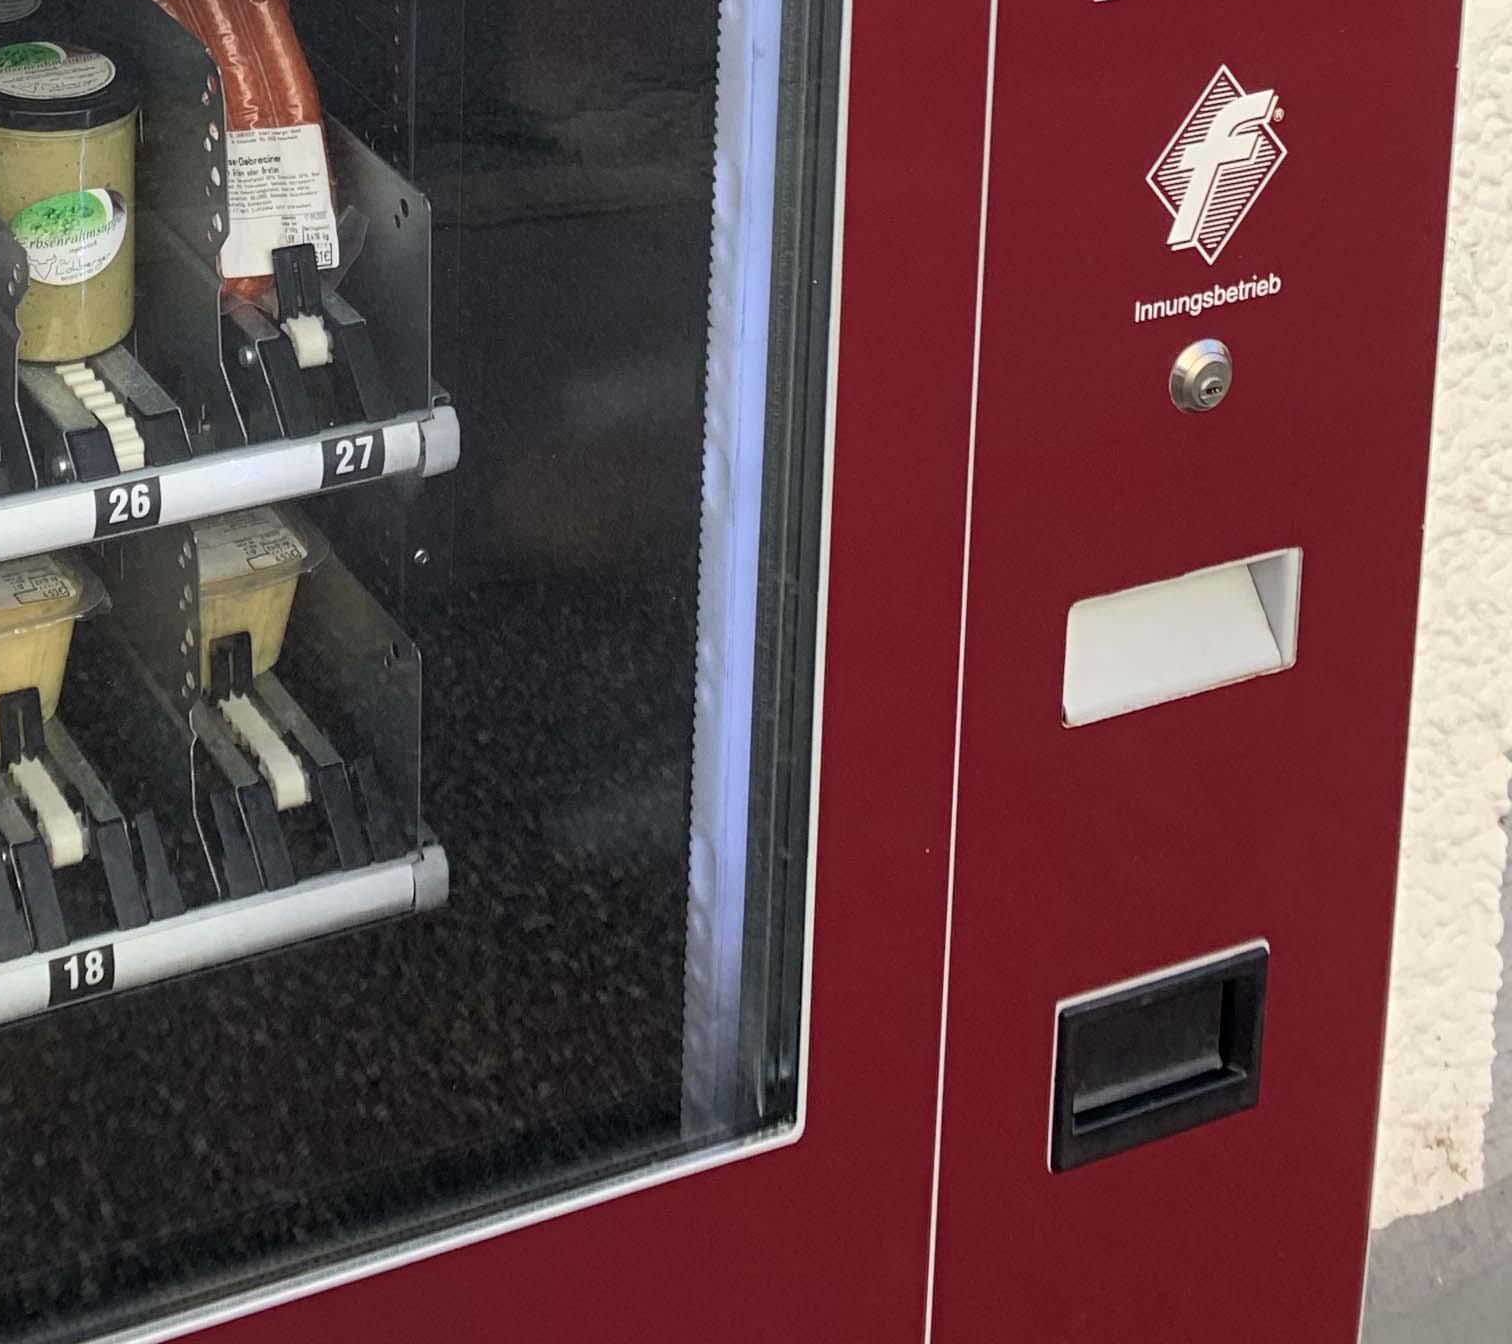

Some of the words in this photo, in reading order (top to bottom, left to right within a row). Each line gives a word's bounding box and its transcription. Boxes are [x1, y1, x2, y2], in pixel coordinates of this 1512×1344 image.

[1134, 273, 1282, 324] Innungsbetrieb
[336, 435, 373, 474] 27
[109, 483, 150, 523] 26
[64, 950, 103, 989] 18
